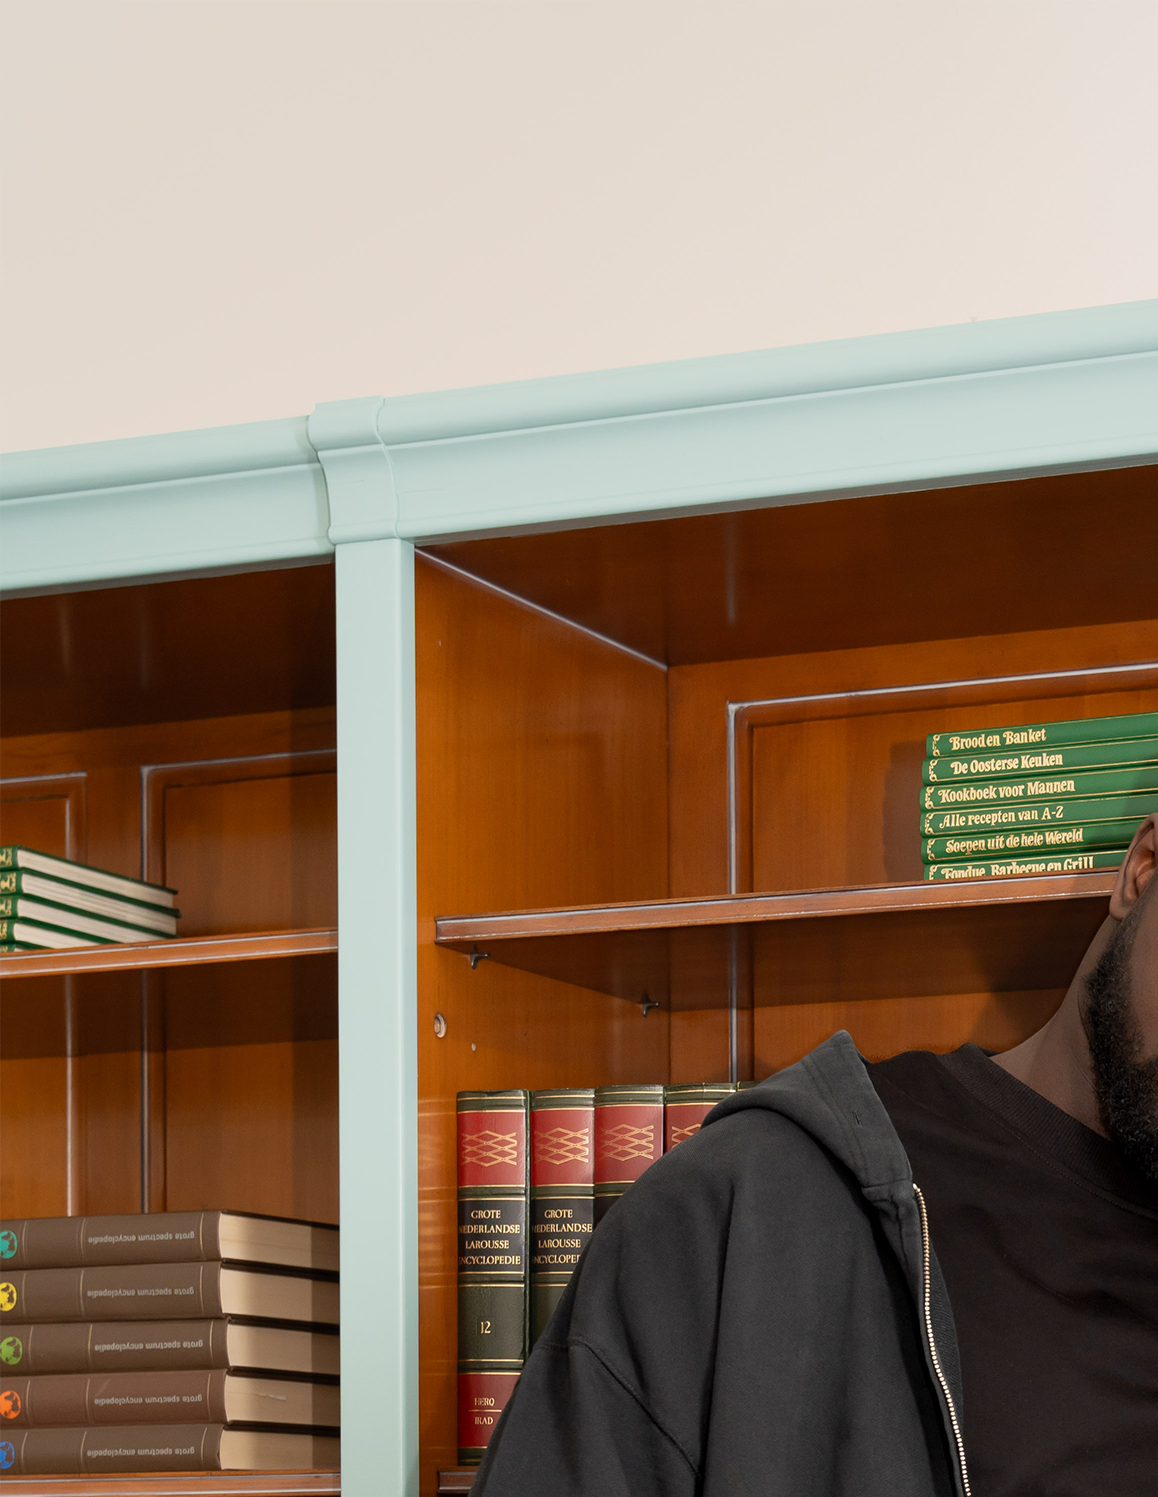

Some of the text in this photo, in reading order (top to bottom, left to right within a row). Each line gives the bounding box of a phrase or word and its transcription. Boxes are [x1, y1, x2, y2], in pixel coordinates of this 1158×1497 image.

[949, 728, 1046, 750] Brood en Banket
[950, 753, 1063, 775] De Oosterse Keuken
[938, 780, 1075, 803] Kookboek voor Mannen
[939, 806, 1064, 828] Alle recepten van A-Z
[946, 828, 1084, 855] Soepen uit de hele Wereld
[471, 1210, 501, 1219] GROTE
[544, 1209, 573, 1218] GROTE
[466, 1240, 509, 1249] LAROUSSE
[539, 1239, 580, 1248] LAROUSSE
[481, 1321, 491, 1333] 12
